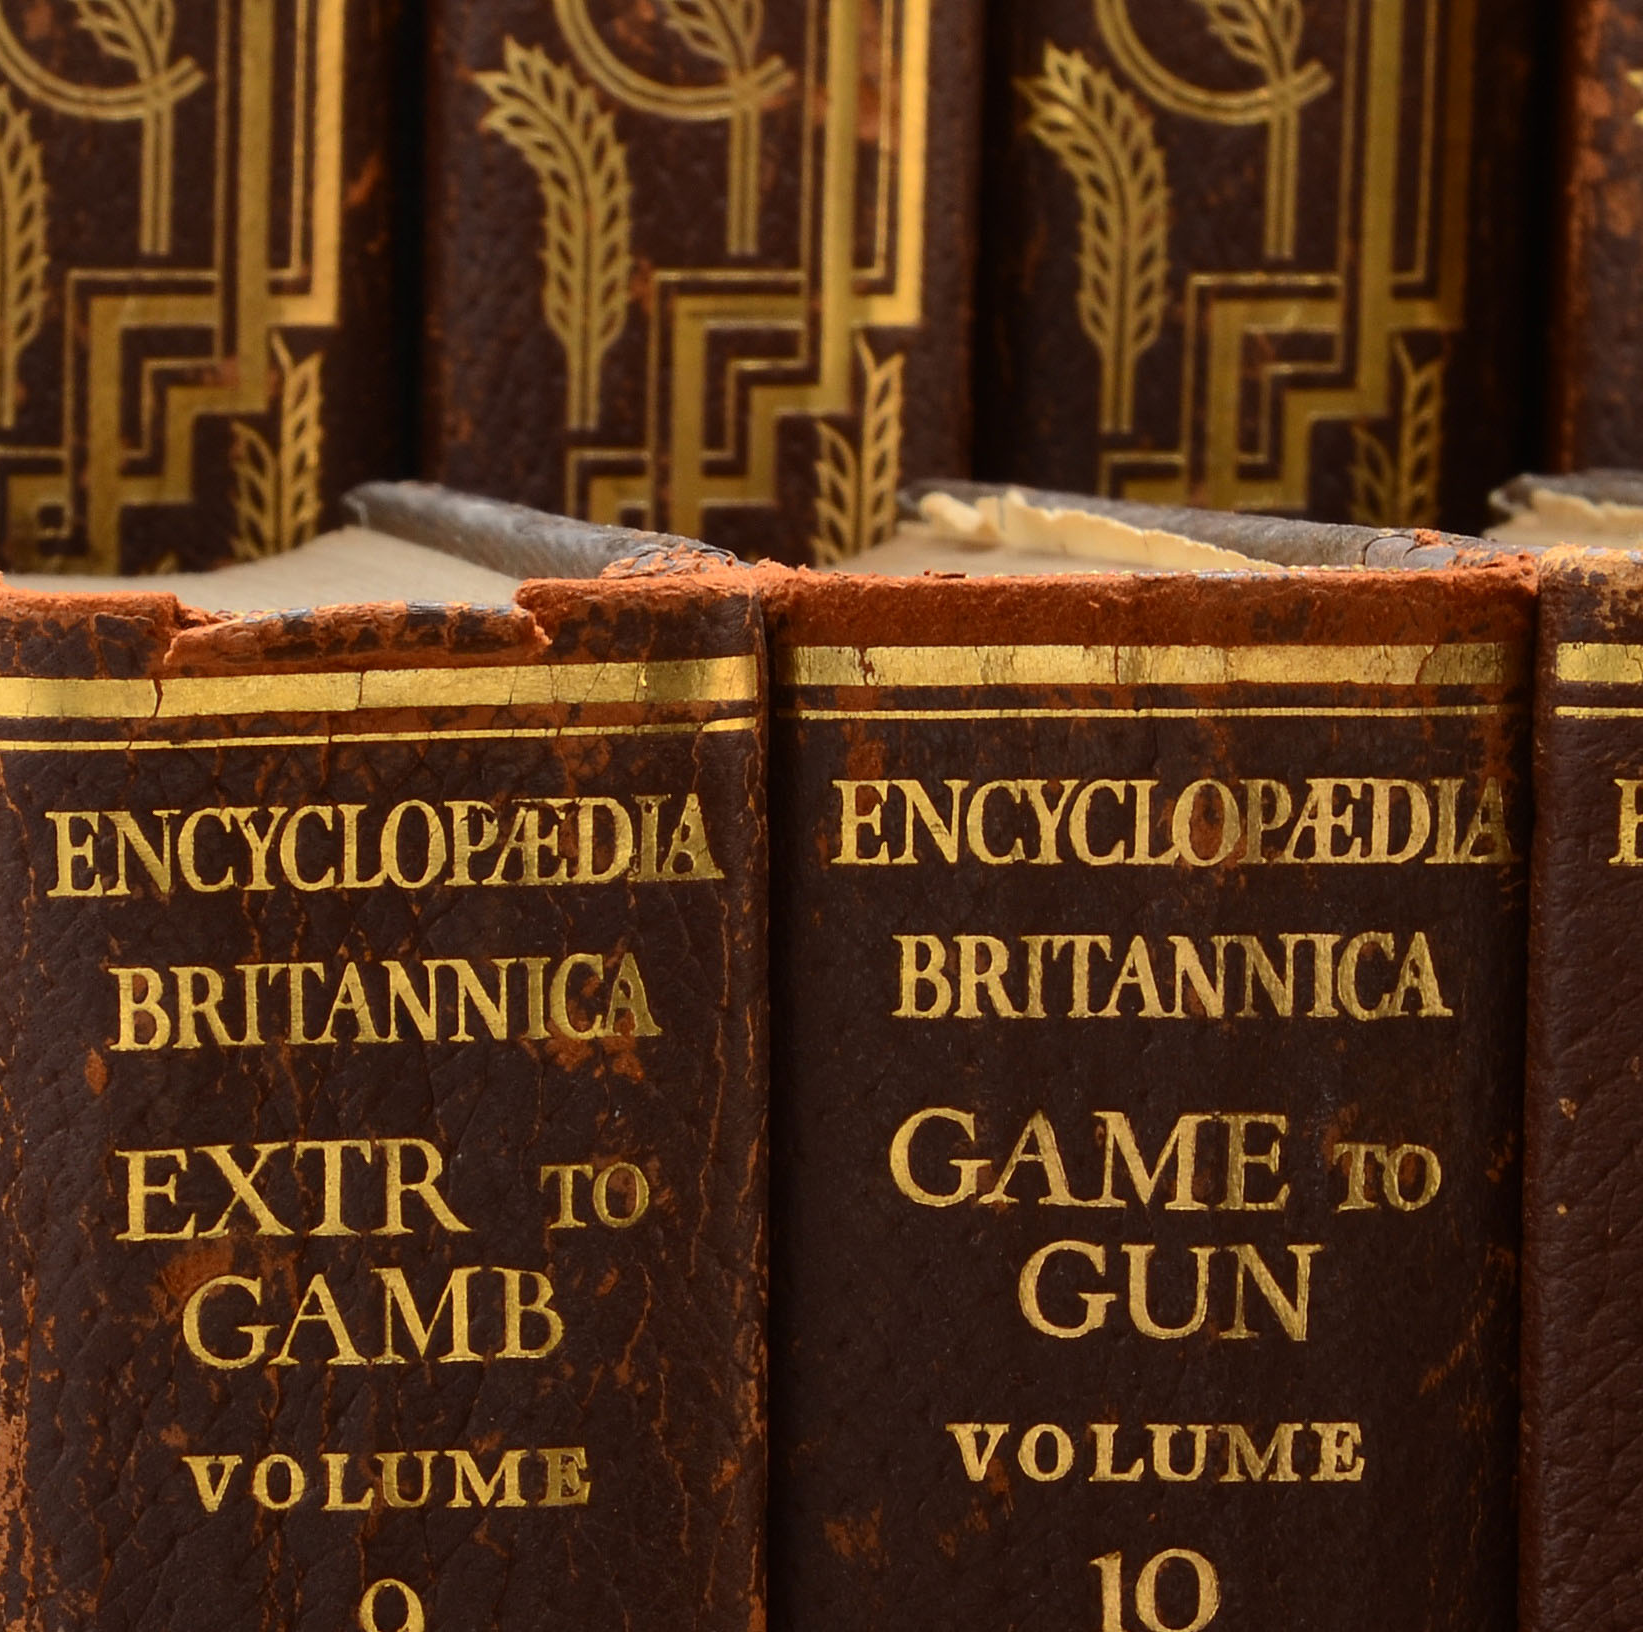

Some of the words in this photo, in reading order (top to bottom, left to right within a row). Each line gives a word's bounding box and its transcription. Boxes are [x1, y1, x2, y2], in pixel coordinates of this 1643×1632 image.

[45, 793, 725, 898] ENCYCLOPÆDIA
[830, 777, 1519, 867] ENCYCLOPÆDIA
[109, 953, 661, 1052] BRITANNICA
[891, 931, 1453, 1021] BRITANNICA
[115, 1138, 470, 1242] EXTR
[539, 1162, 649, 1229] TO
[888, 1108, 1290, 1212] GAME
[1332, 1142, 1443, 1213] TO
[182, 1266, 565, 1370] GAMB
[1019, 1241, 1325, 1342] GUN
[182, 1447, 591, 1514] VOLUME
[945, 1422, 1367, 1484] VOLUME
